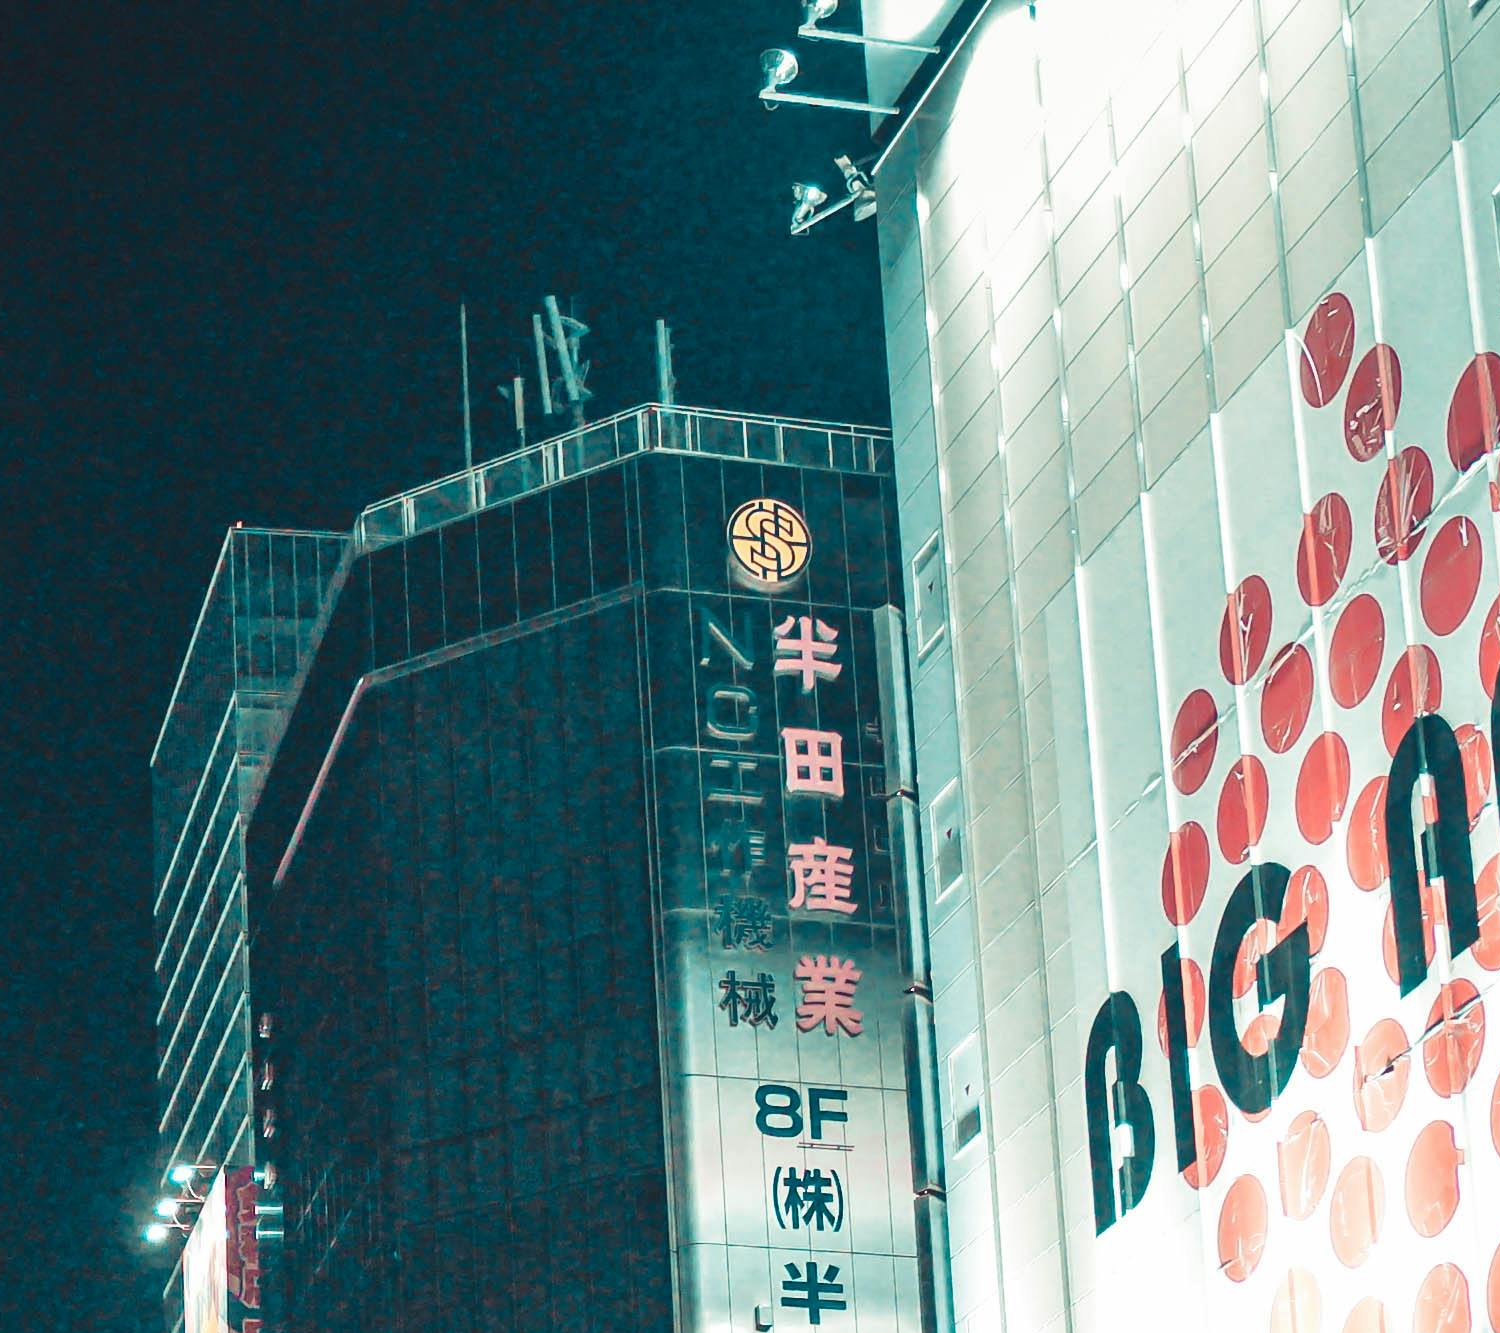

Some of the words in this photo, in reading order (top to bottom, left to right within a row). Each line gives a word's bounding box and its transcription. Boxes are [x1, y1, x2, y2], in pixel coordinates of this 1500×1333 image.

[772, 614, 866, 1038] 半田産業
[753, 1083, 849, 1141] 8F
[1085, 861, 1311, 1238] BIG
